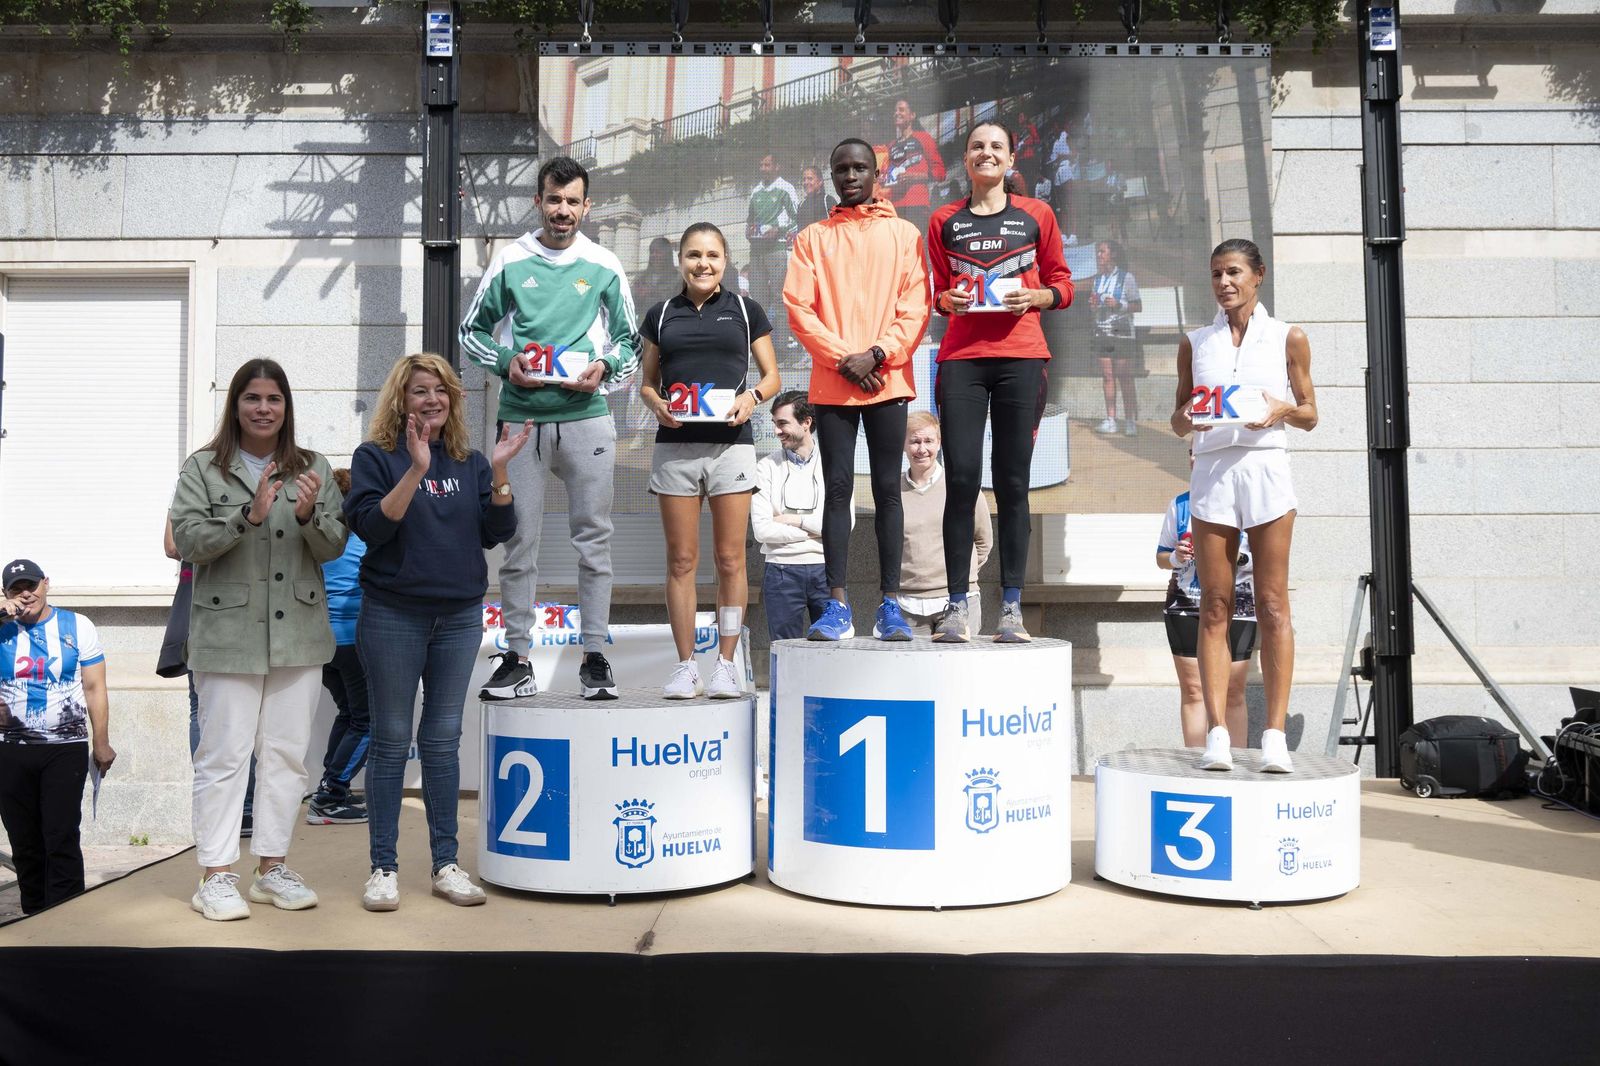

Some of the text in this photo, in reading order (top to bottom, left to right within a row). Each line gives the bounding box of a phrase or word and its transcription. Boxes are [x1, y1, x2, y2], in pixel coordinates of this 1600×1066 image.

[982, 240, 1002, 250] BM
[524, 342, 569, 377] 21K
[669, 382, 715, 417] 21K
[1190, 384, 1240, 419] 21K
[544, 606, 576, 629] 21K
[15, 656, 59, 684] 21K
[688, 766, 722, 780] original
[839, 715, 887, 833] 1
[497, 750, 548, 847] 2
[1005, 804, 1052, 823] HUELVA
[662, 828, 713, 842] Ayuntamiento
[1164, 799, 1216, 871] 3
[662, 838, 722, 858] HUELVA
[1302, 859, 1333, 871] HUELVA
